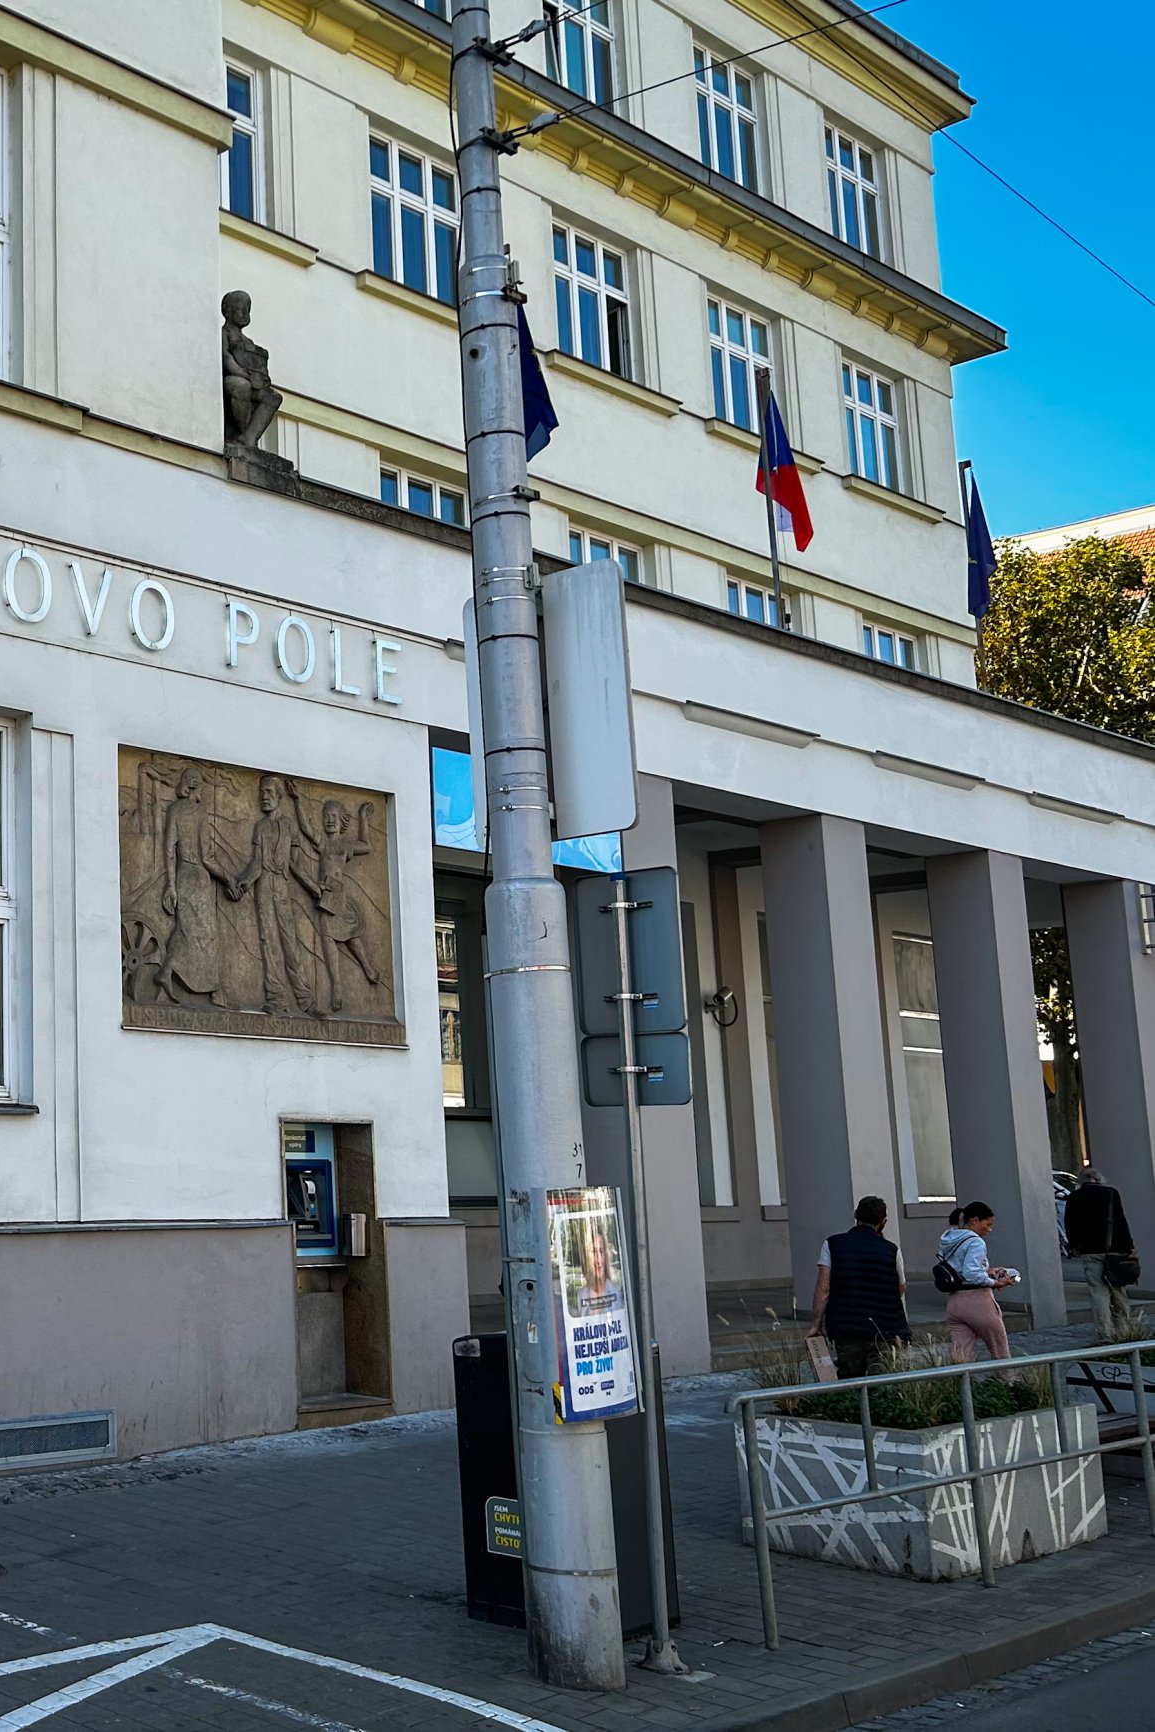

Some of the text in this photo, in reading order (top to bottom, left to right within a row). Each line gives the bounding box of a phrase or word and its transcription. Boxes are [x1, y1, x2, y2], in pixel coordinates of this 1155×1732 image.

[228, 600, 403, 705] POLE
[576, 1163, 583, 1179] 7
[573, 1323, 607, 1342] KRÁLOVO
[574, 1336, 609, 1359] NEJLEPŠÍ
[576, 1356, 613, 1376] PRO ŽIVOT
[578, 1385, 594, 1395] ODS
[494, 1505, 508, 1513] JSEM
[496, 1534, 521, 1548] ČISTO
